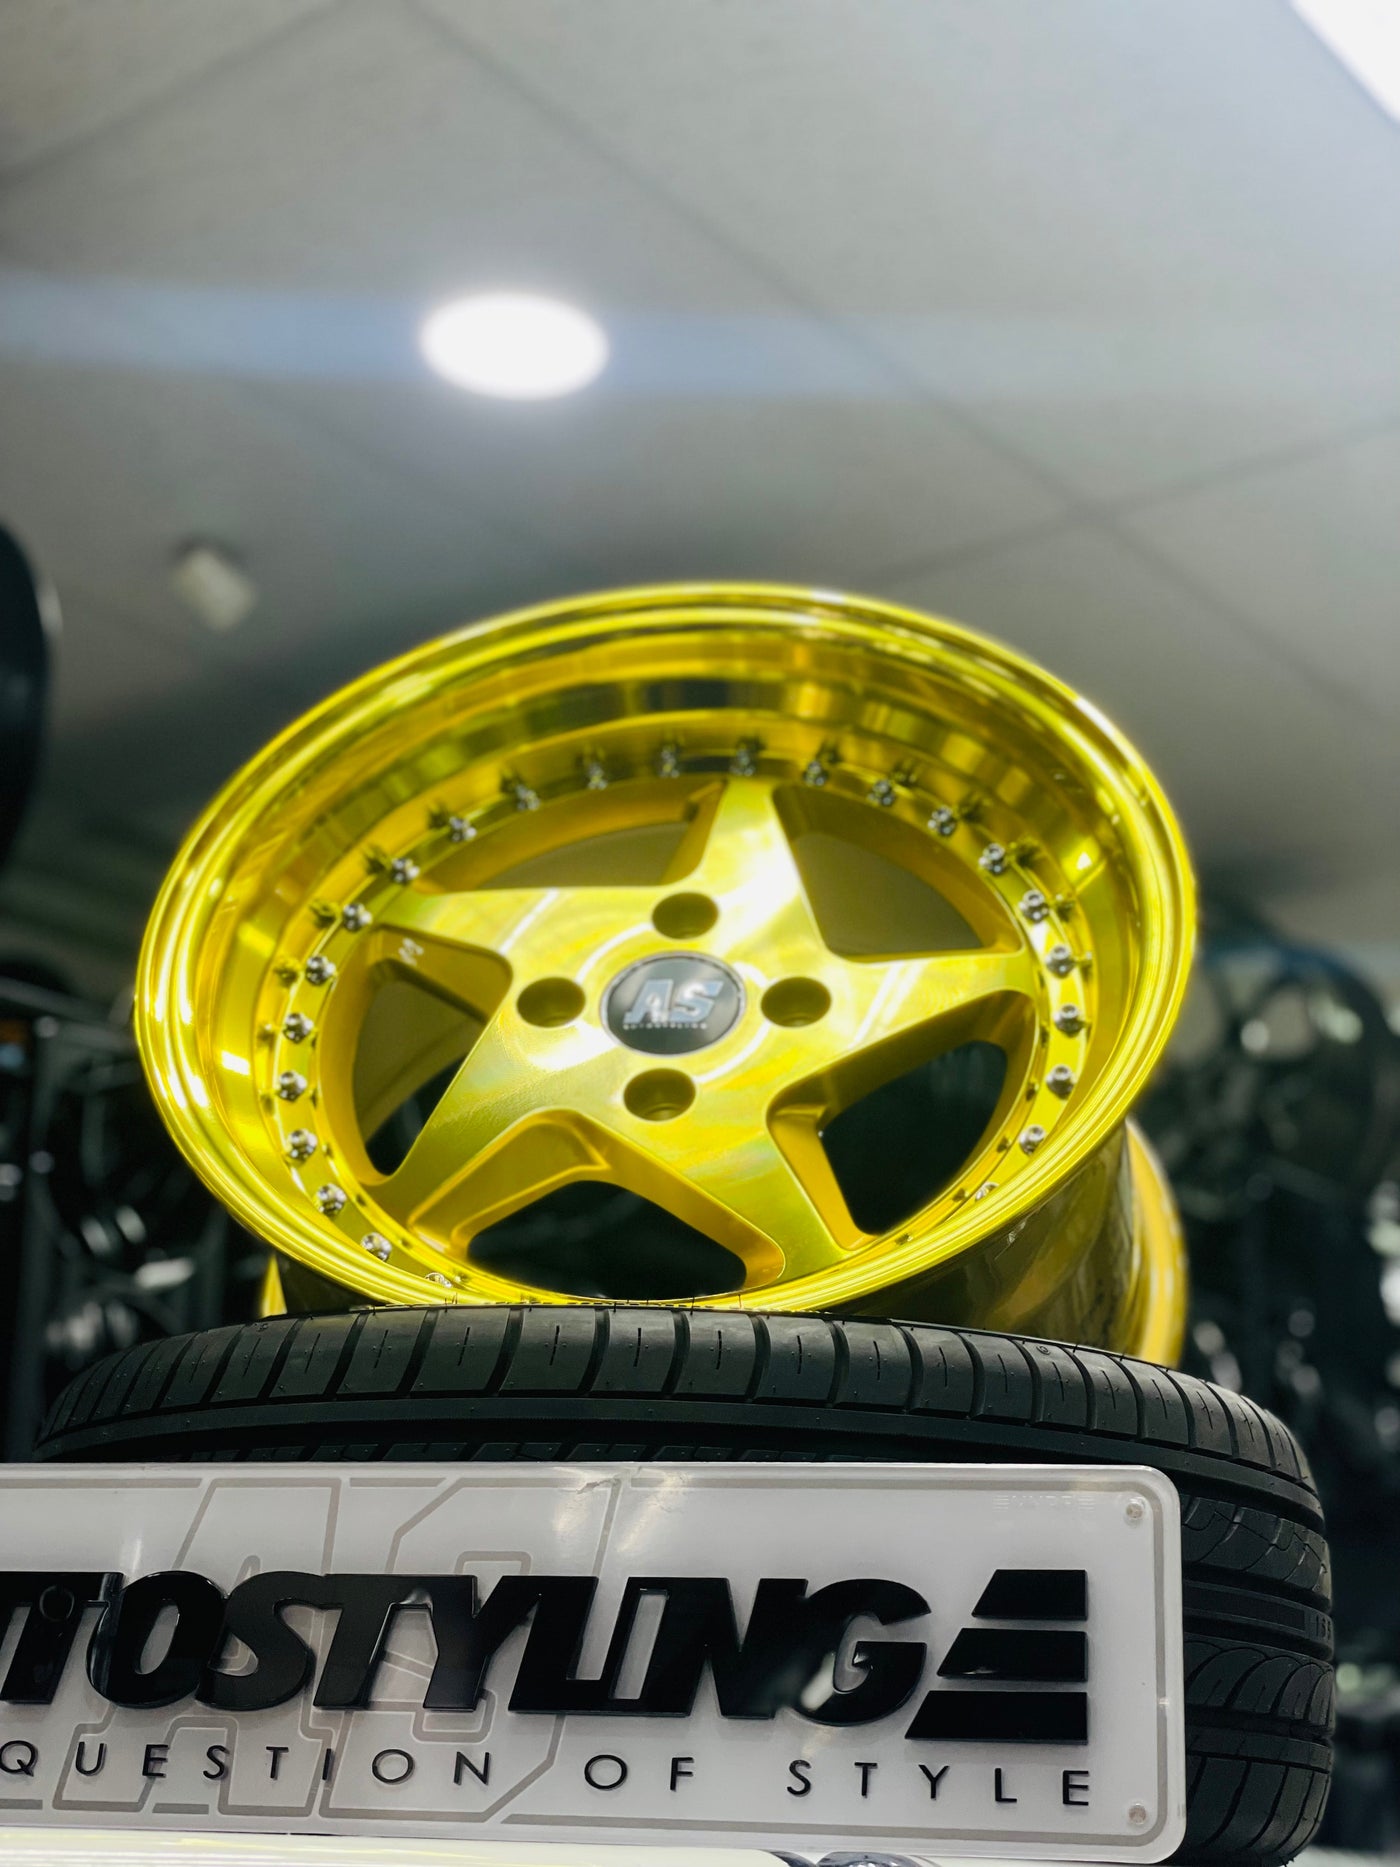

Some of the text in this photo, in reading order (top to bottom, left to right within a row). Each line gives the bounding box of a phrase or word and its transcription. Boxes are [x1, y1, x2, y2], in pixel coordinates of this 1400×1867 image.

[623, 978, 724, 1024] AS
[0, 1570, 932, 1727] TOSTYLING
[0, 1739, 1090, 1807] QUESTION OF STYLE
